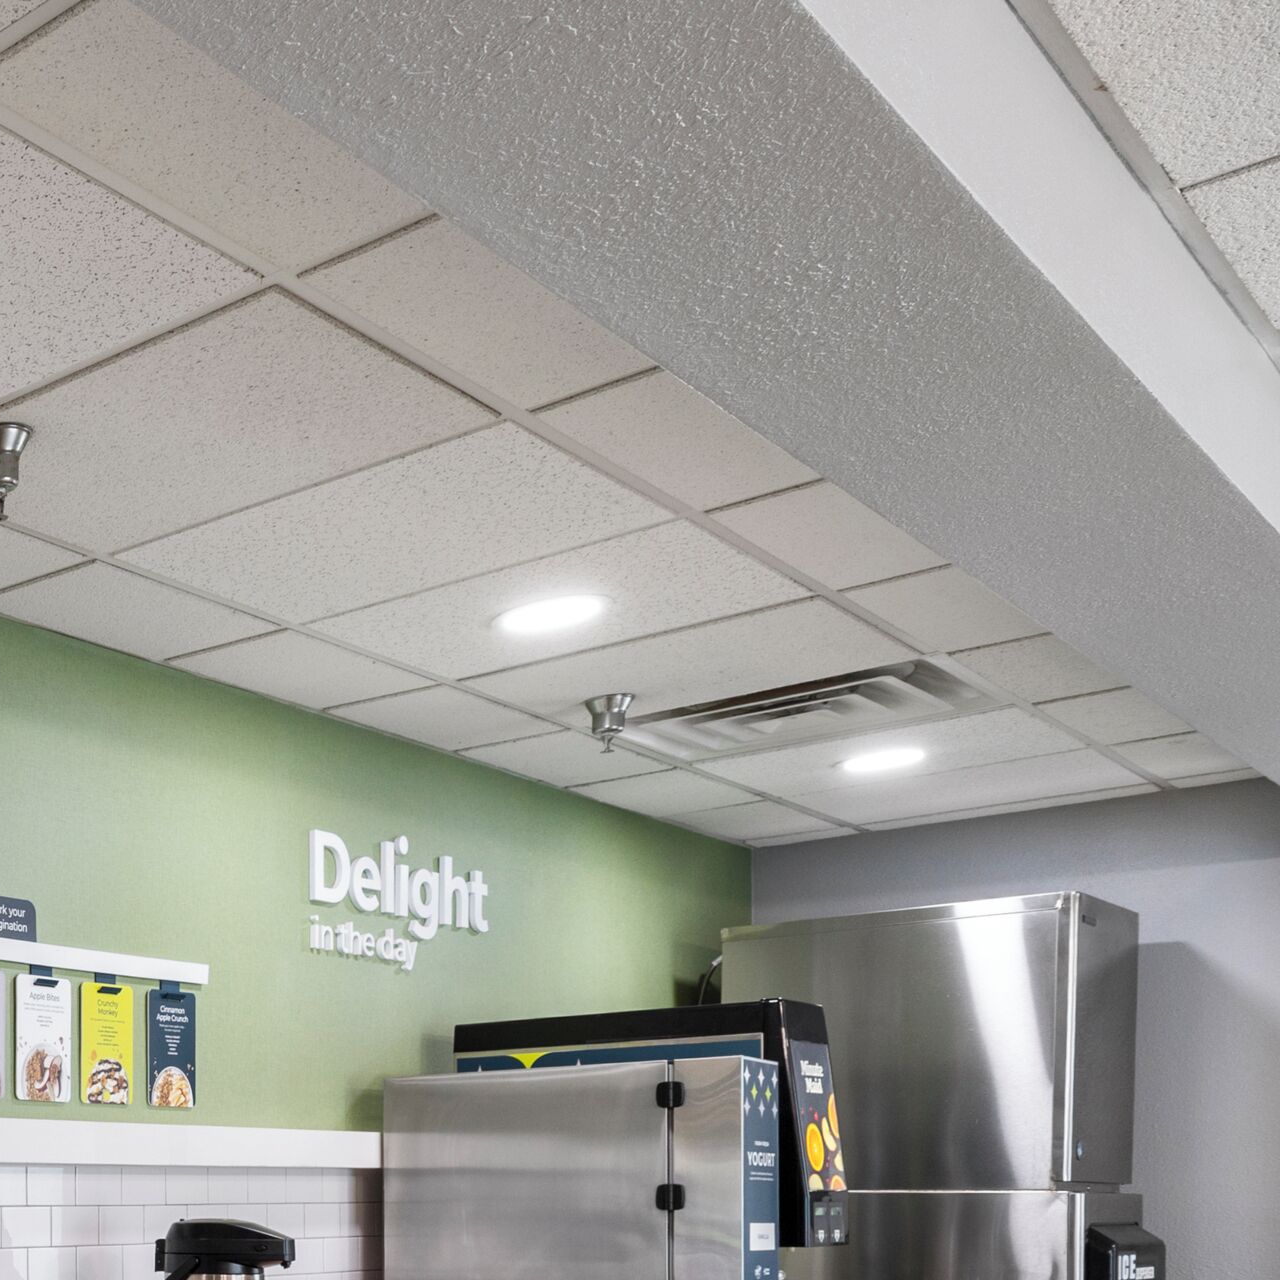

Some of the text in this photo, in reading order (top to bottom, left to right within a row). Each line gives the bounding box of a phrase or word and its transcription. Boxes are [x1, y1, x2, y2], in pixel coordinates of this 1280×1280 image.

[309, 829, 489, 941] Delight
[8, 908, 26, 918] your
[309, 914, 418, 971] in the day
[29, 992, 46, 1001] Apple
[97, 999, 119, 1009] Crunchy
[160, 1005, 185, 1014] Cinnamon
[156, 1013, 189, 1023] Apple Crunch
[747, 1151, 776, 1167] YOGURT
[1118, 1254, 1137, 1280] ICE
